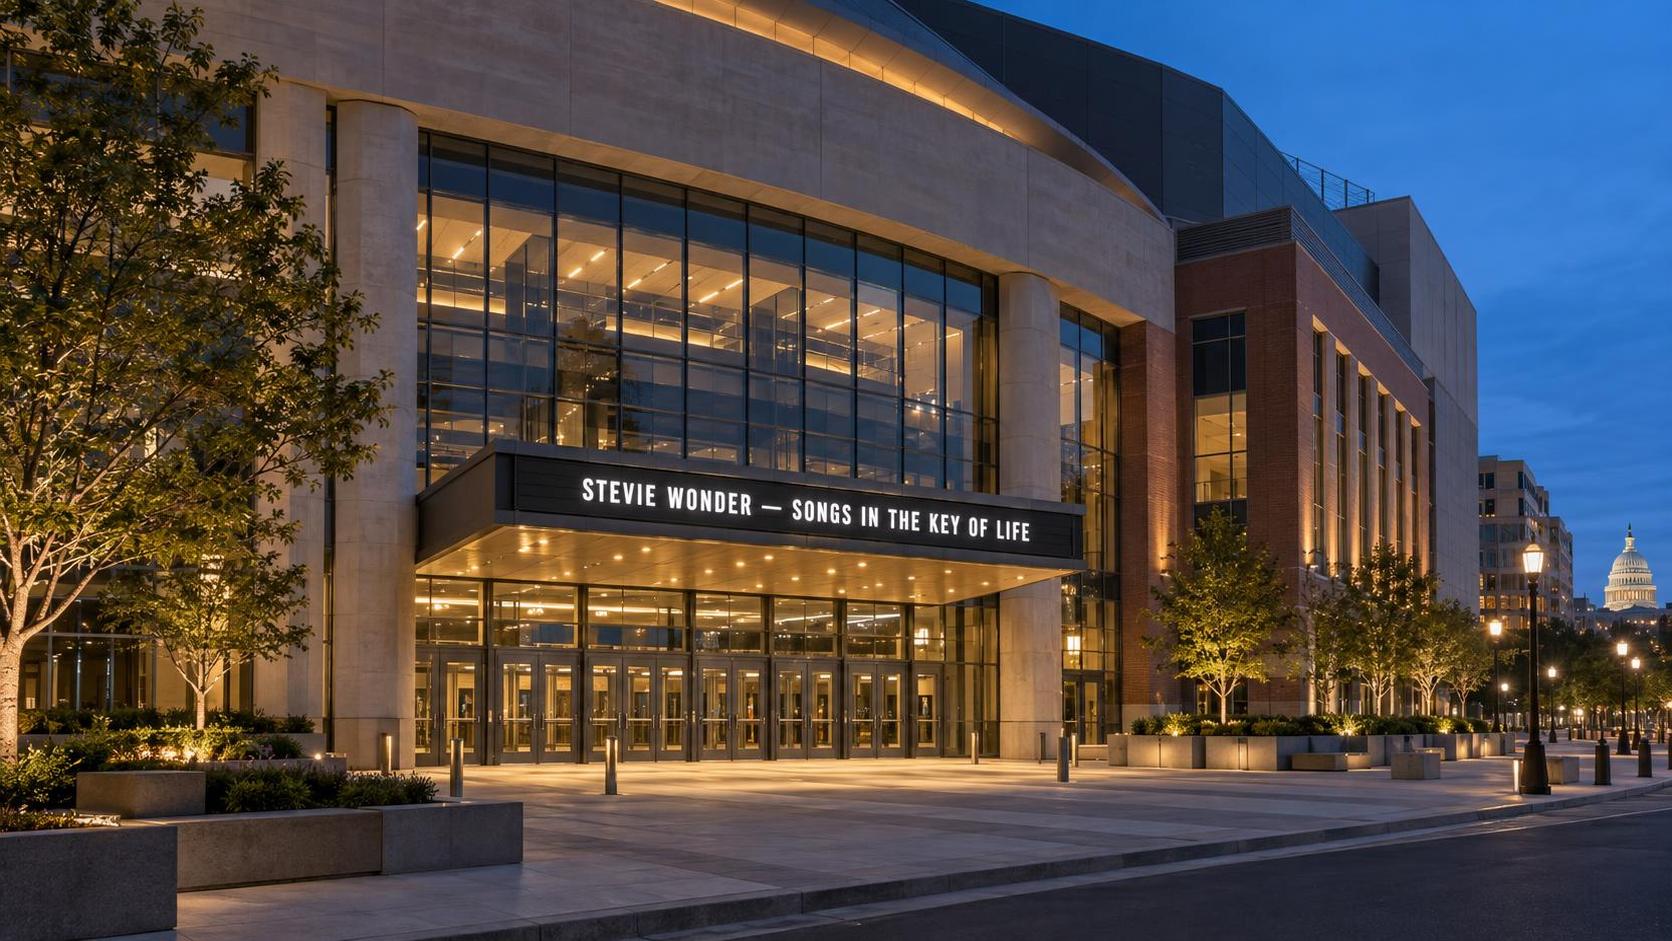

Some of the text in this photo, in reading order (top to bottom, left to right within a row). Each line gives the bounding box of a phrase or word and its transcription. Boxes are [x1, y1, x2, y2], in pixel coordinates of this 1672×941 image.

[581, 477, 656, 507] STEVIE
[666, 486, 752, 516] WONDER
[792, 498, 852, 526] SONGS
[861, 505, 879, 528] IN
[887, 508, 921, 532] THE
[929, 512, 961, 536] KEY
[968, 516, 989, 538] OF
[996, 519, 1030, 542] LIFE
